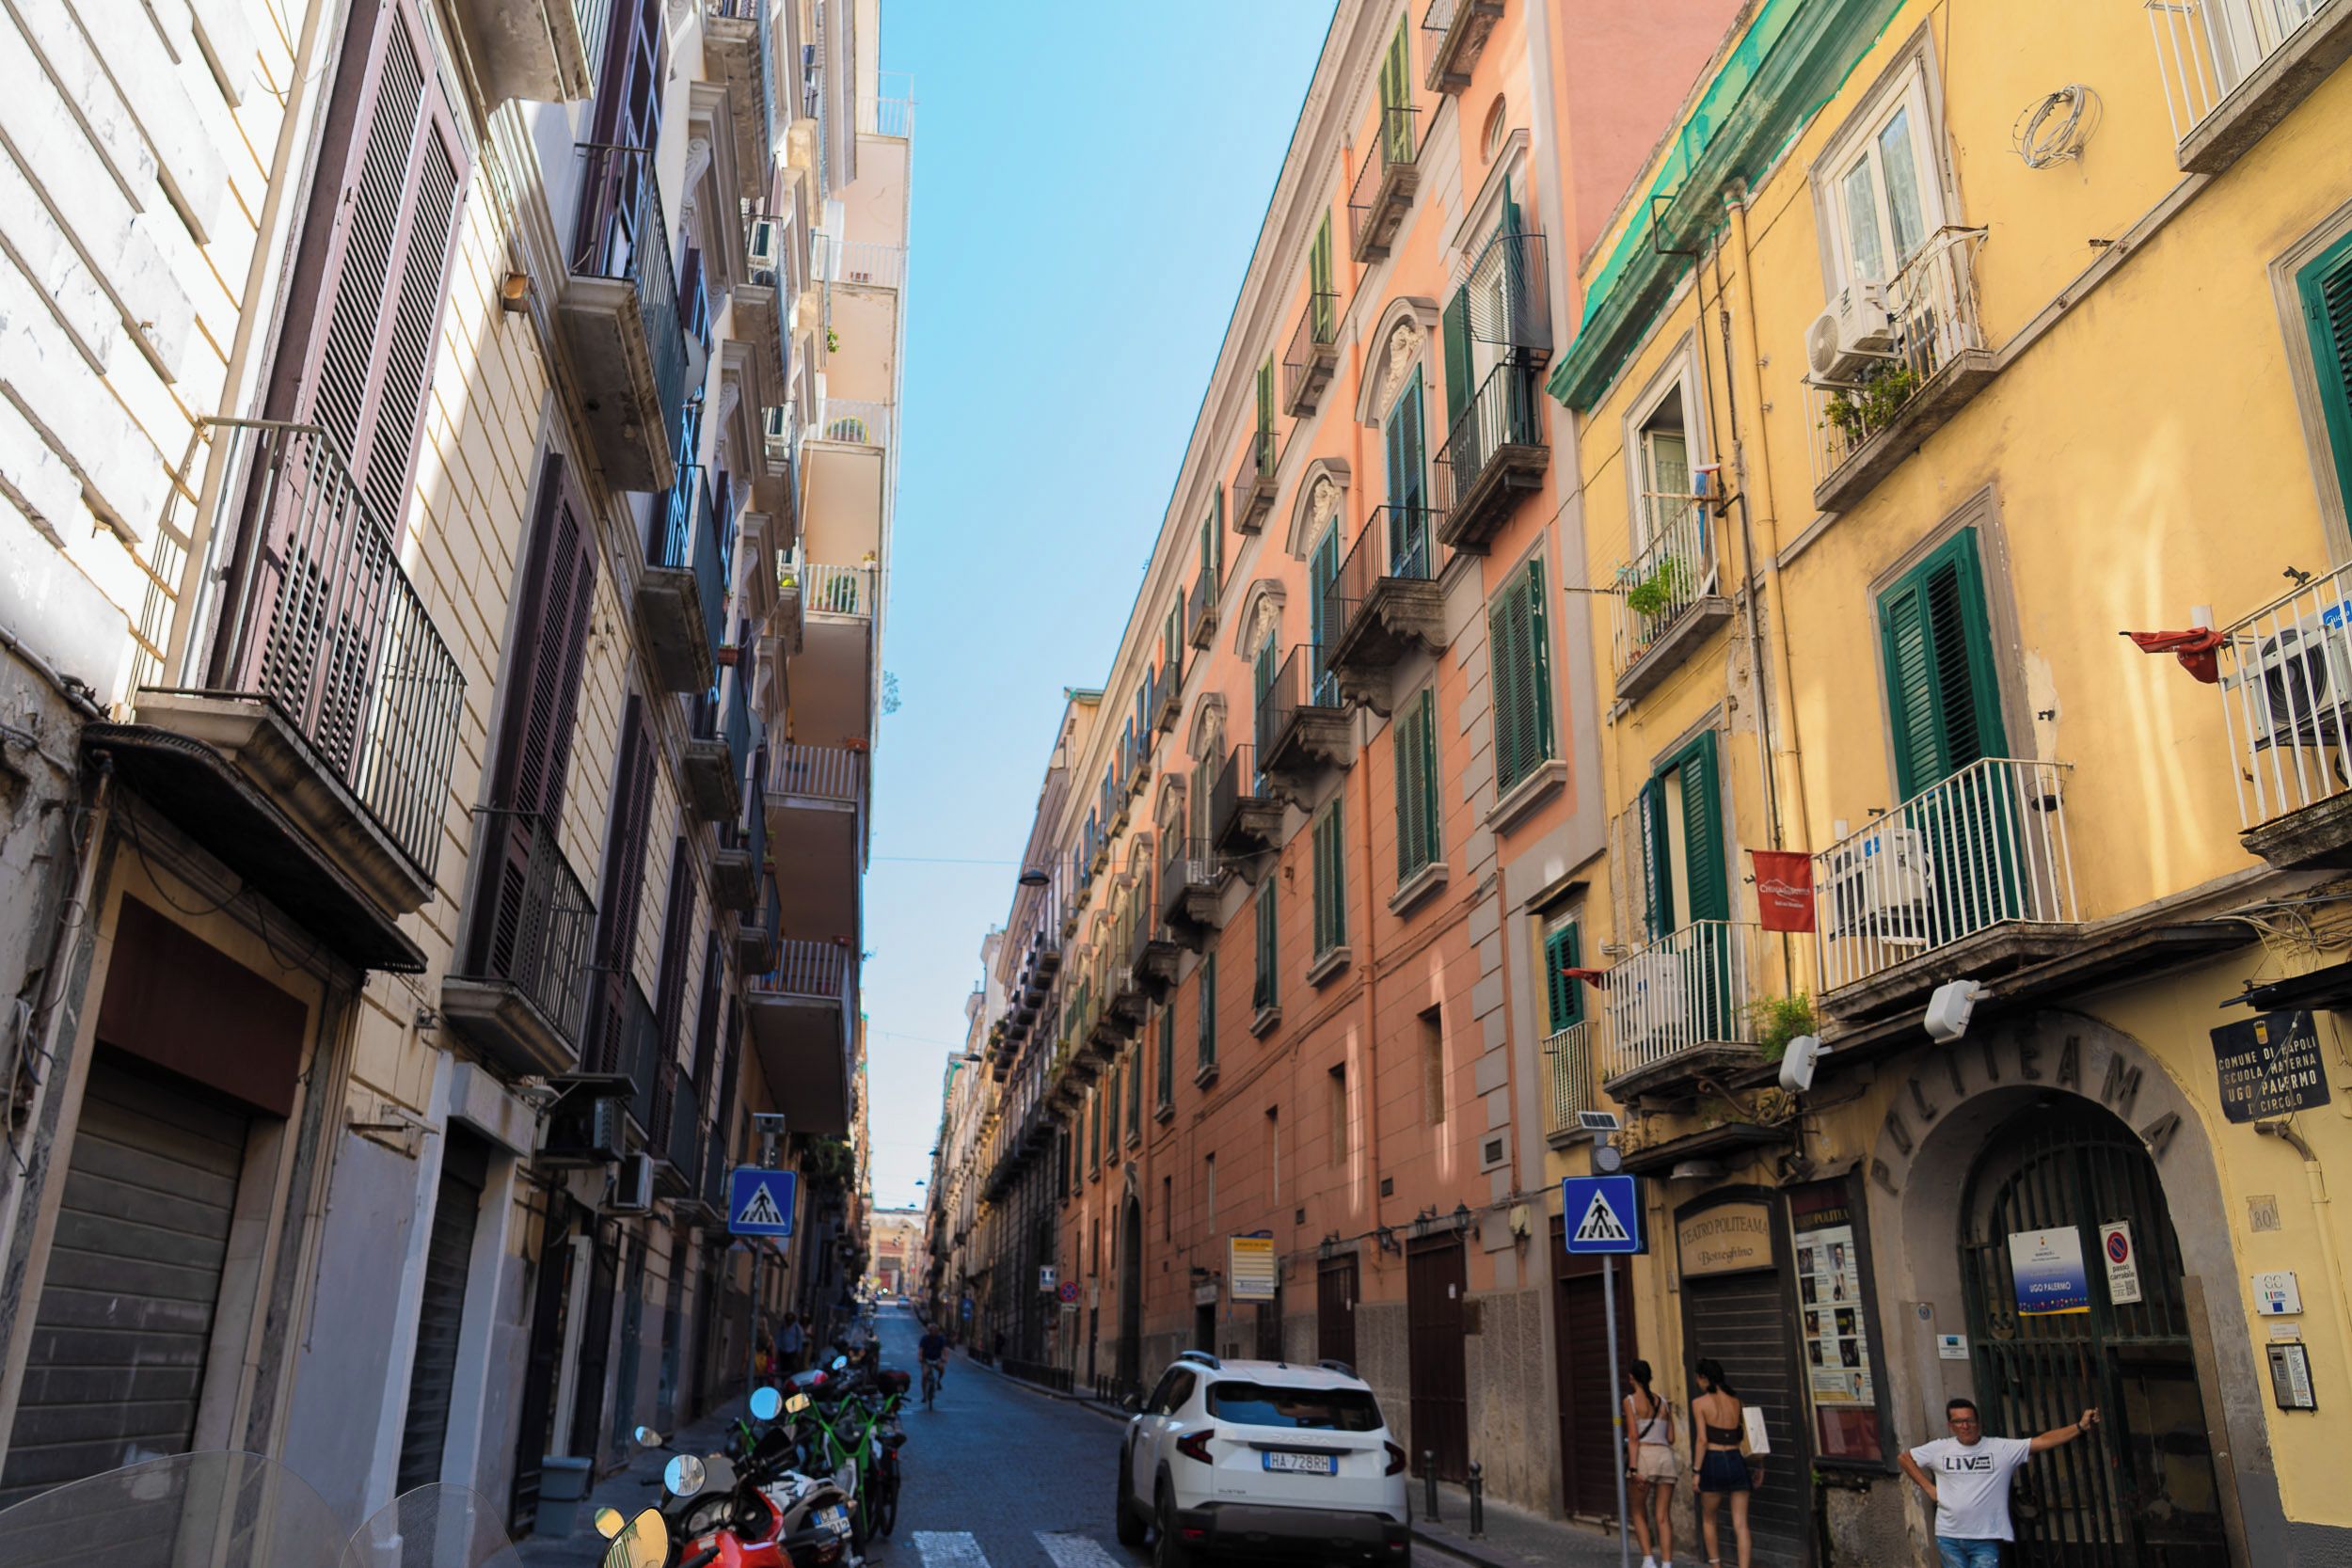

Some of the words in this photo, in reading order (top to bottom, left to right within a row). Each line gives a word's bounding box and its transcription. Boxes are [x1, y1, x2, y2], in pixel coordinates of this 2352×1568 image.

[2218, 1051, 2257, 1070] COMUNE
[2263, 1047, 2274, 1060] DI
[2224, 1067, 2263, 1085] SCUOLA
[2270, 1053, 2316, 1074] MATERNA
[2229, 1085, 2251, 1102] UGO
[2262, 1070, 2316, 1095] PALERMO
[2254, 1211, 2272, 1227] 80
[1681, 1222, 1715, 1246] TEATRO
[1715, 1215, 1769, 1237] POLITEAMA
[1698, 1247, 1754, 1266] Botteghino
[2110, 1270, 2135, 1280] carrabile
[2112, 1263, 2130, 1273] passo
[2029, 1283, 2042, 1292] UGO
[2044, 1281, 2071, 1291] PALERMO
[1271, 1453, 1286, 1467] HA
[1291, 1454, 1328, 1469] 728RH
